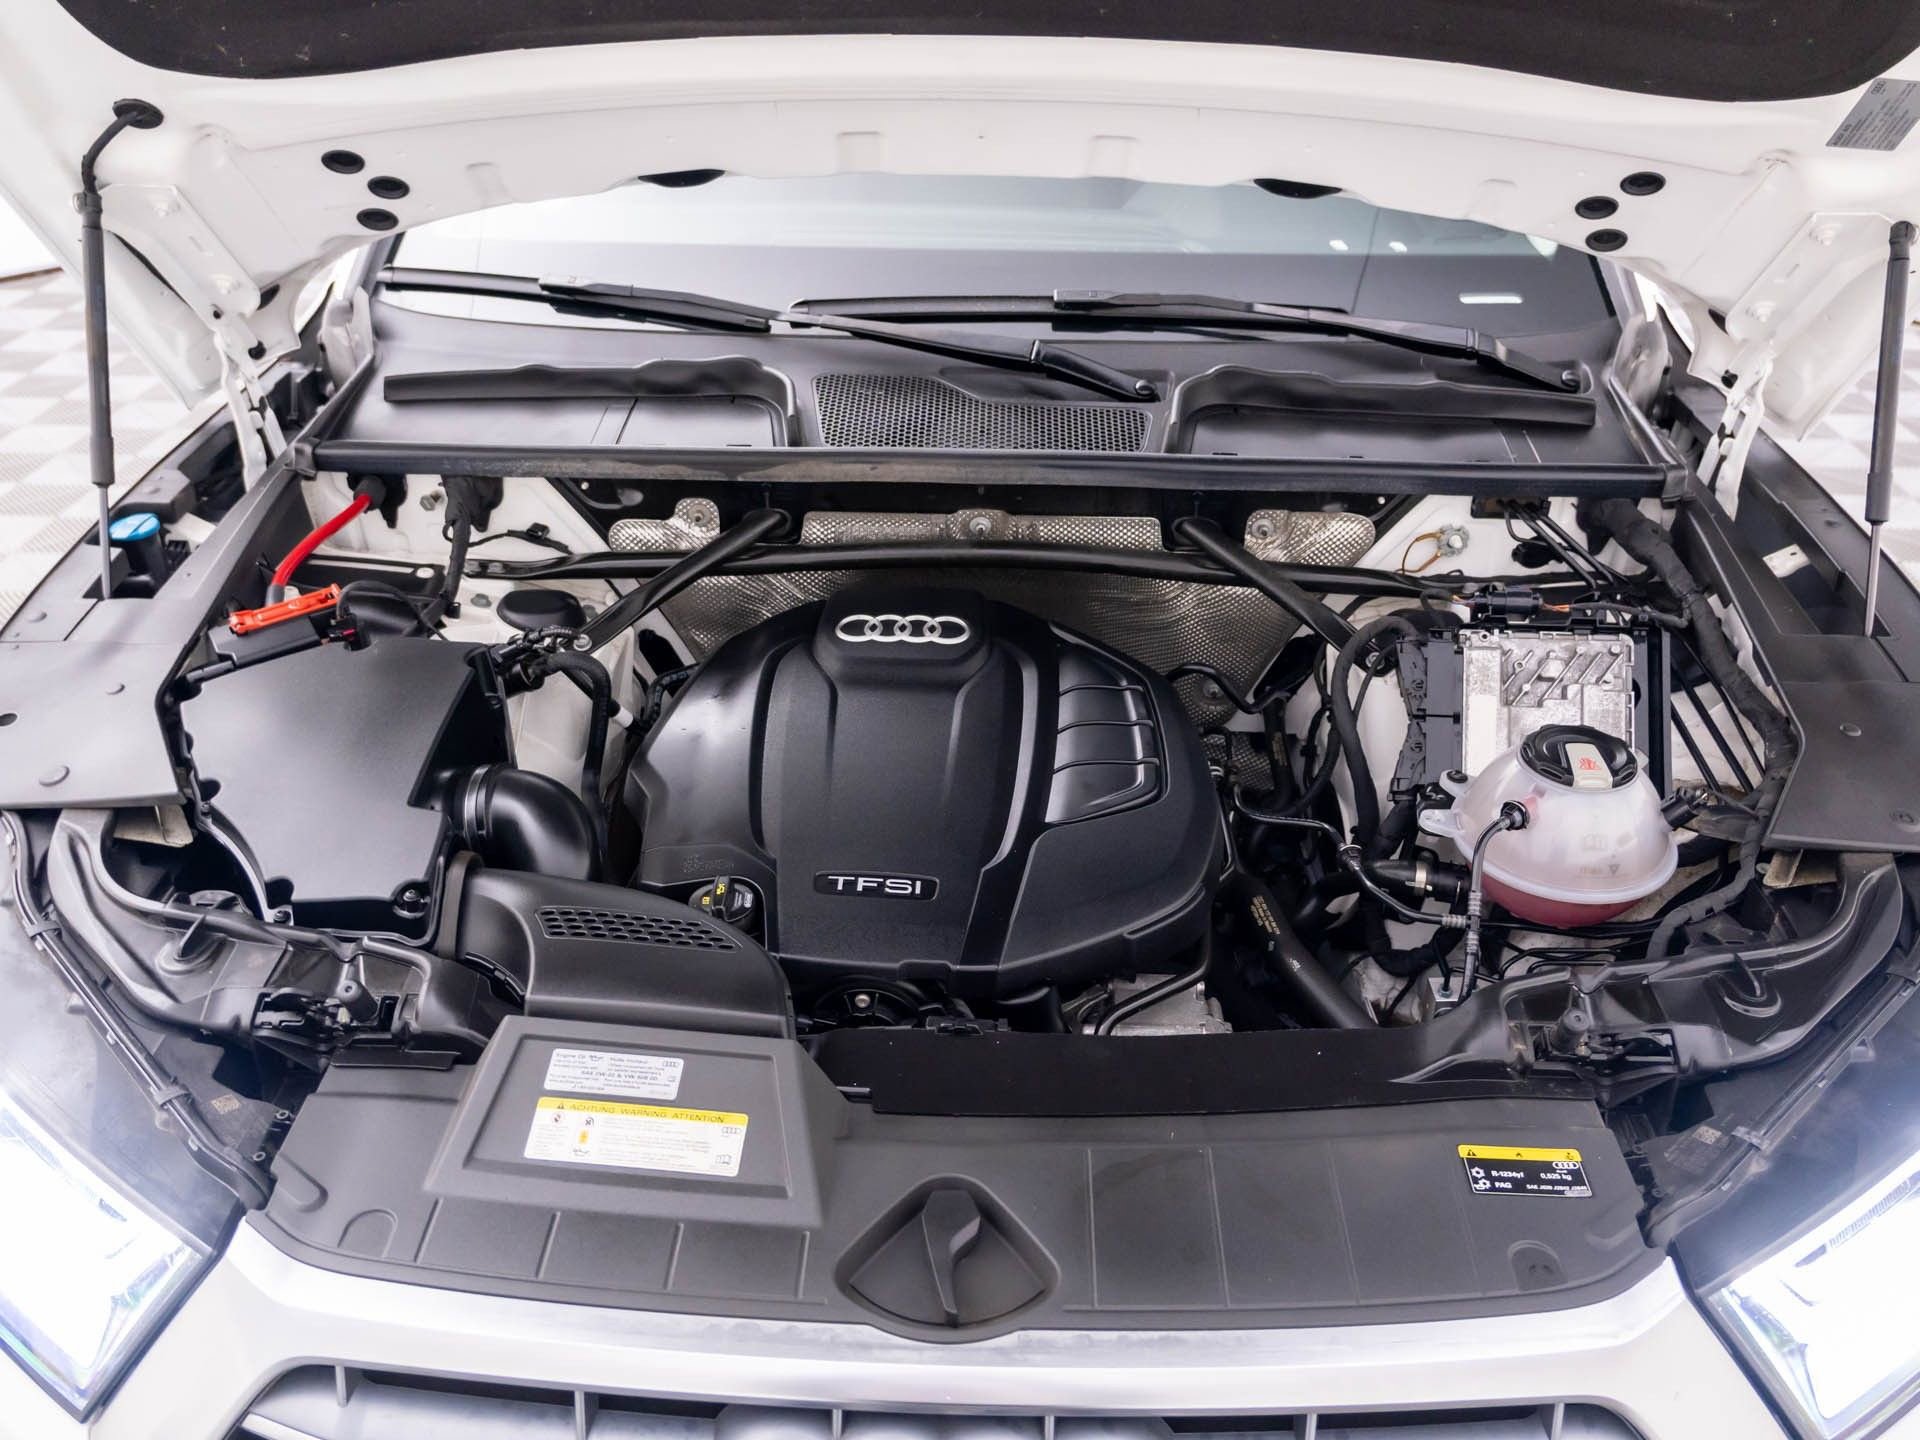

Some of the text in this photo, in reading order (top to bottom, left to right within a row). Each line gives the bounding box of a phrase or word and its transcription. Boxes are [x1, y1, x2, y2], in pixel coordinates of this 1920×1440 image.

[828, 875, 922, 895] TFSI
[569, 1103, 726, 1124] ACHTUNG WARNING ATTENTION
